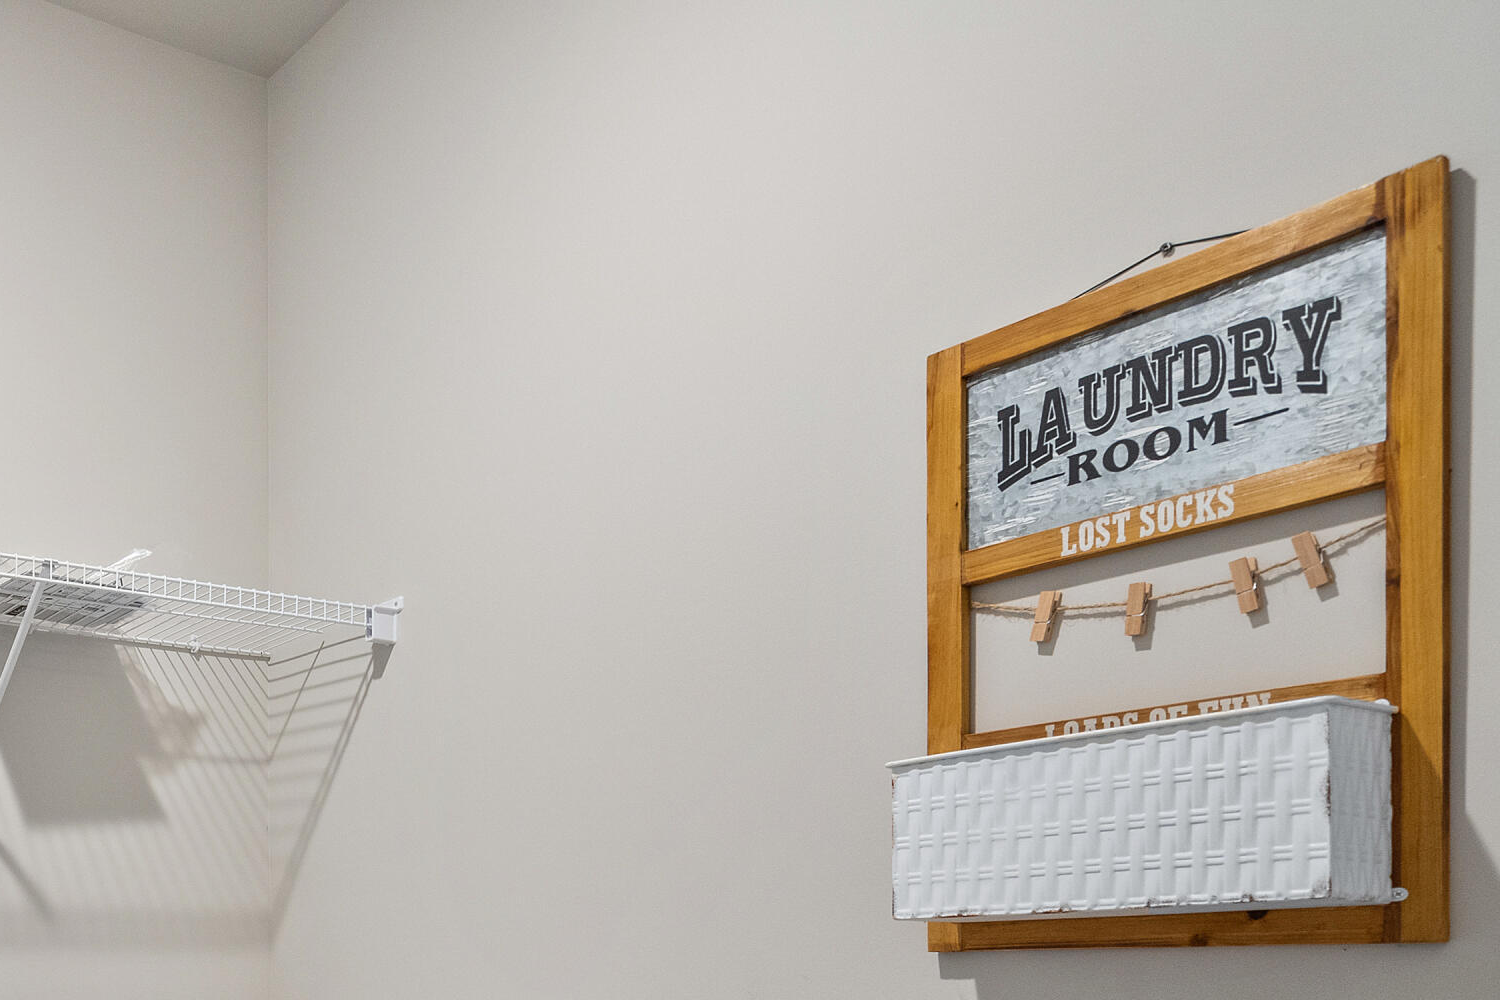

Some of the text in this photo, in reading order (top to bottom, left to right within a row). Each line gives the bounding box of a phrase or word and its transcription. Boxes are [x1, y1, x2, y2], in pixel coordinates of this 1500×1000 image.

[997, 296, 1342, 492] LAUNDRY
[1067, 408, 1229, 486] ROOM
[1060, 484, 1235, 557] LOST SOCKS
